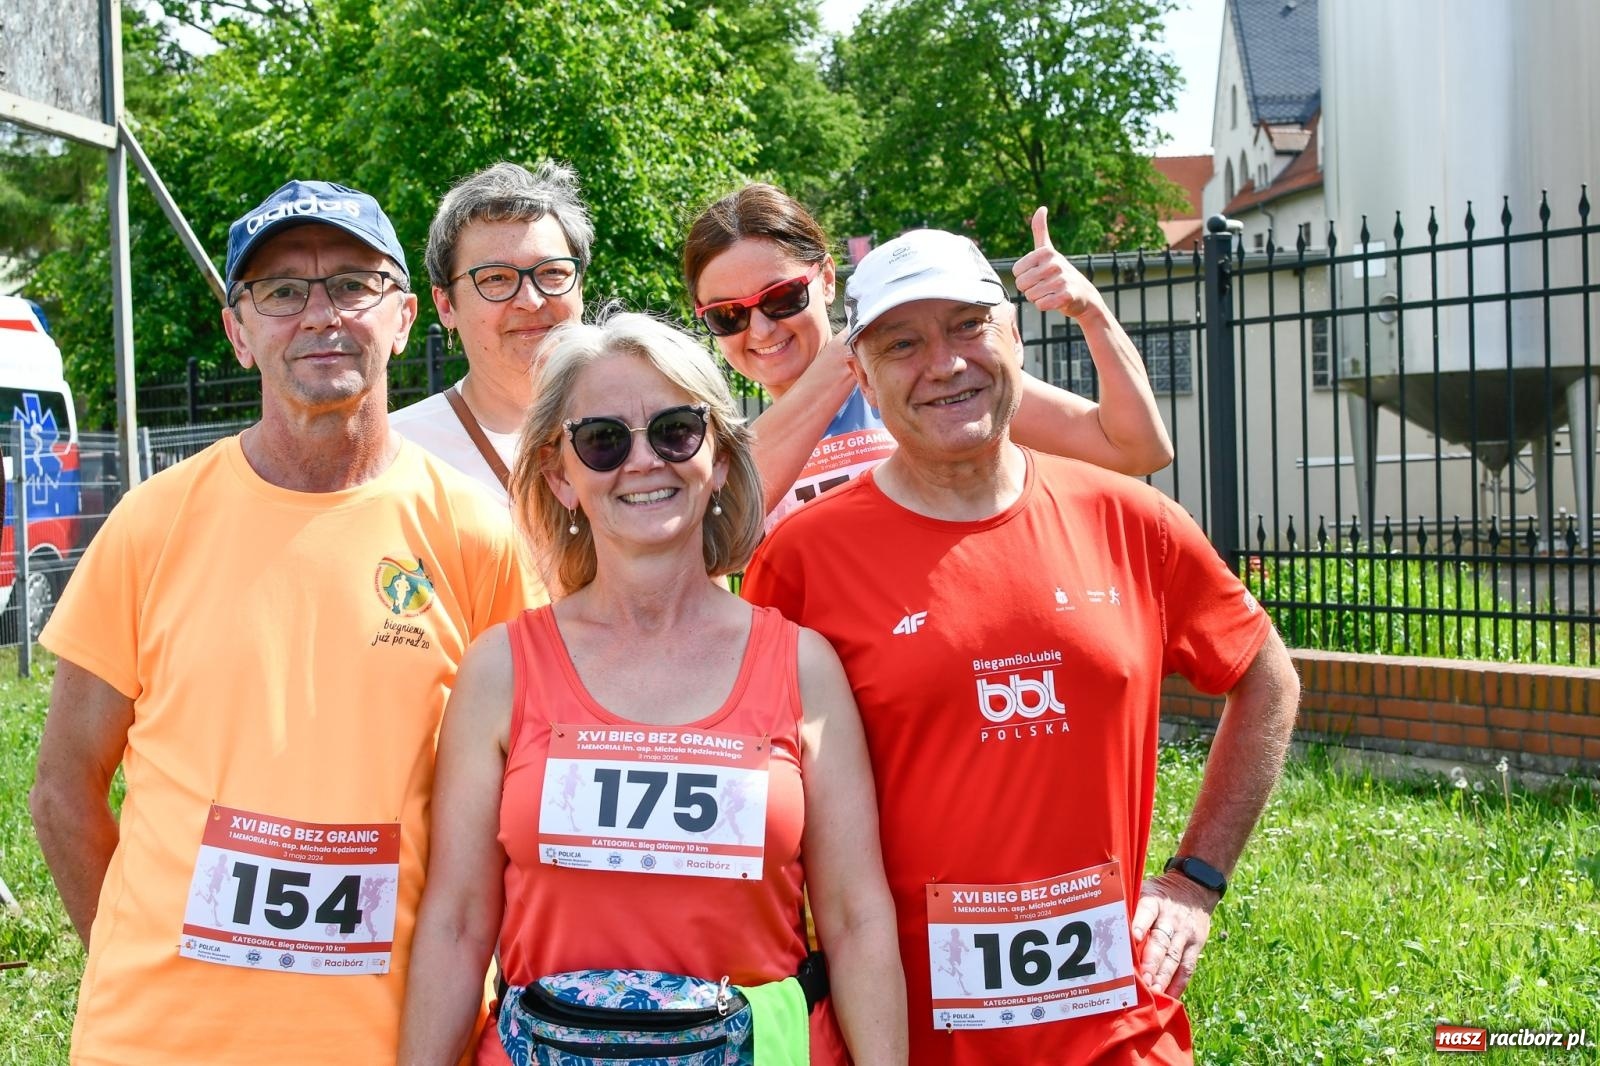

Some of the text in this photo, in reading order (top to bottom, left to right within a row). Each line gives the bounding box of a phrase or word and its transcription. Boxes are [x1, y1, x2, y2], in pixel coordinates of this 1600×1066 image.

[246, 195, 360, 235] adidas
[822, 440, 845, 455] BEZ
[384, 618, 425, 640] biegniemy
[893, 610, 928, 634] 4F
[391, 635, 403, 646] po
[421, 640, 430, 649] 20
[972, 649, 1062, 671] BiegamBoLubię
[976, 670, 1066, 722] bbl
[577, 730, 744, 751] XVI BIEG BEZ GRANIC
[981, 721, 1070, 742] POLSKA
[581, 743, 621, 751] MEMORIAŁ
[636, 746, 653, 754] asp.
[654, 745, 686, 754] Michała
[687, 748, 742, 760] Kędzierskiego
[644, 754, 661, 762] maja
[593, 768, 719, 833] 175
[230, 815, 379, 843] XVI BIEG BEZ GRANIC
[233, 832, 268, 846] MEMORIAŁ
[268, 839, 281, 848] im.
[282, 842, 299, 851] asp.
[299, 844, 331, 853] Michała
[332, 846, 378, 856] Kędzierskiego
[558, 850, 581, 858] POLICJA
[592, 839, 709, 853] KATEGORIA: Bieg Główny 10 km
[289, 853, 307, 861] maja
[686, 859, 730, 870] Racibórz
[232, 861, 363, 934] 154
[952, 873, 1102, 904] XVI BIEG BEZ GRANIC
[957, 905, 996, 913] MEMORIAŁ
[1011, 904, 1028, 914] asp.
[1028, 899, 1057, 911] Michała
[1058, 889, 1102, 906] Kędzierskiego
[1019, 911, 1036, 920] maja
[1037, 910, 1052, 918] 2024
[199, 943, 221, 952] POLICJA
[232, 935, 277, 948] KATEGORIA:
[278, 941, 295, 950] Bieg
[296, 942, 324, 953] Główny
[324, 959, 363, 967] Racibórz
[973, 920, 1097, 990] 162
[983, 997, 1026, 1007] KATEGORIA:
[1027, 995, 1042, 1004] Bieg
[1043, 990, 1069, 1002] Główny
[1079, 987, 1090, 995] km
[1072, 997, 1111, 1010] Racibórz
